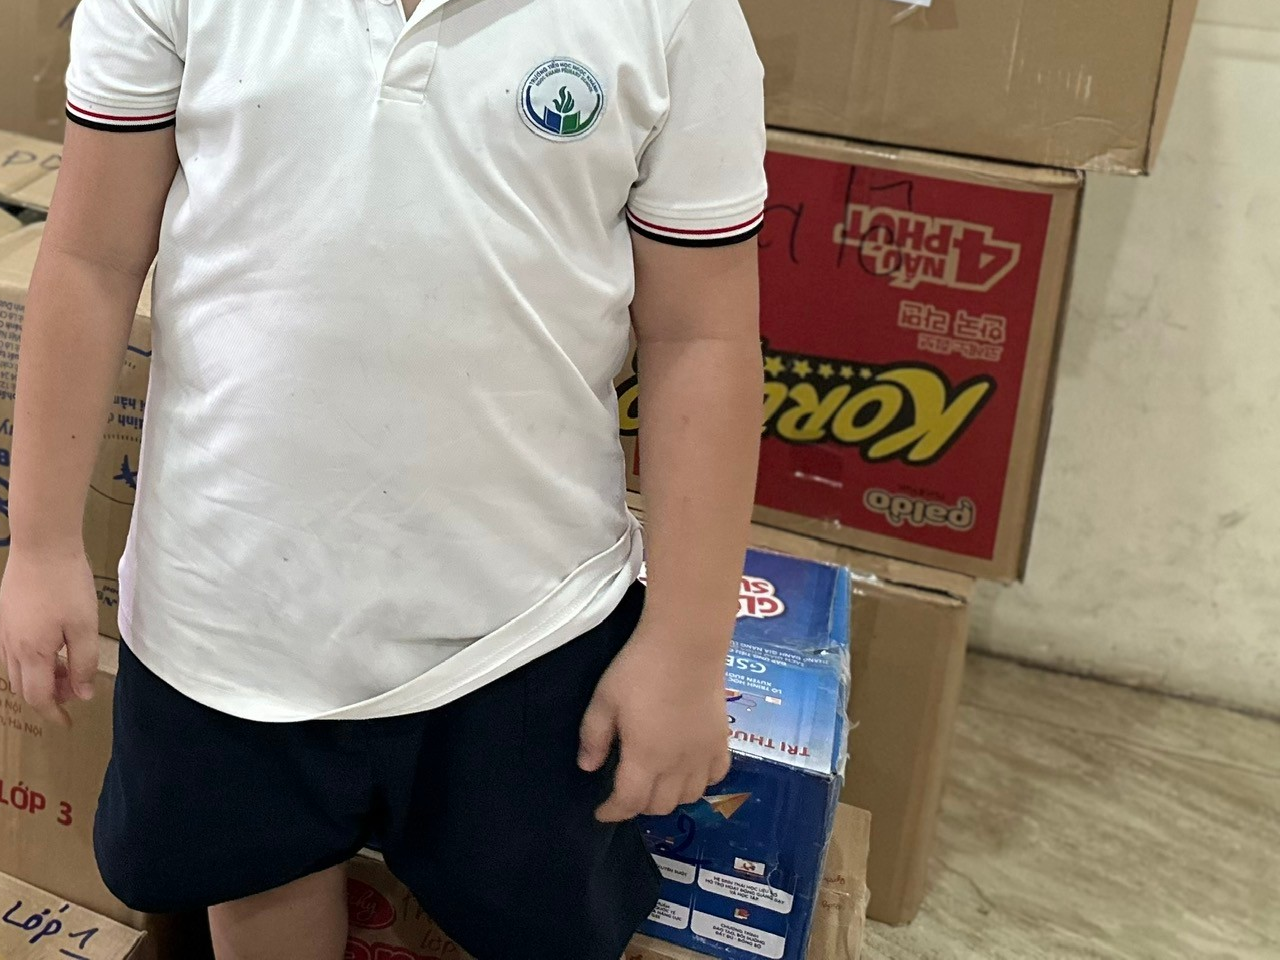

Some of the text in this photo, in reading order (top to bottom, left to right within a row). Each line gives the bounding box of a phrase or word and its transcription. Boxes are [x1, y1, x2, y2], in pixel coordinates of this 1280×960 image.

[529, 67, 548, 85] TRƯỜNG
[572, 65, 587, 76] NGỌC
[587, 75, 599, 93] KHÁNH
[950, 222, 1021, 293] 4
[898, 301, 1007, 343] 한국 라면
[865, 490, 974, 530] paldo
[725, 654, 767, 673] GSE
[4, 696, 23, 715] Nội
[8, 713, 23, 731] Hà
[23, 719, 44, 739] Nội
[779, 741, 810, 757] TRI
[56, 801, 74, 828] 3
[62, 924, 101, 958] 1
